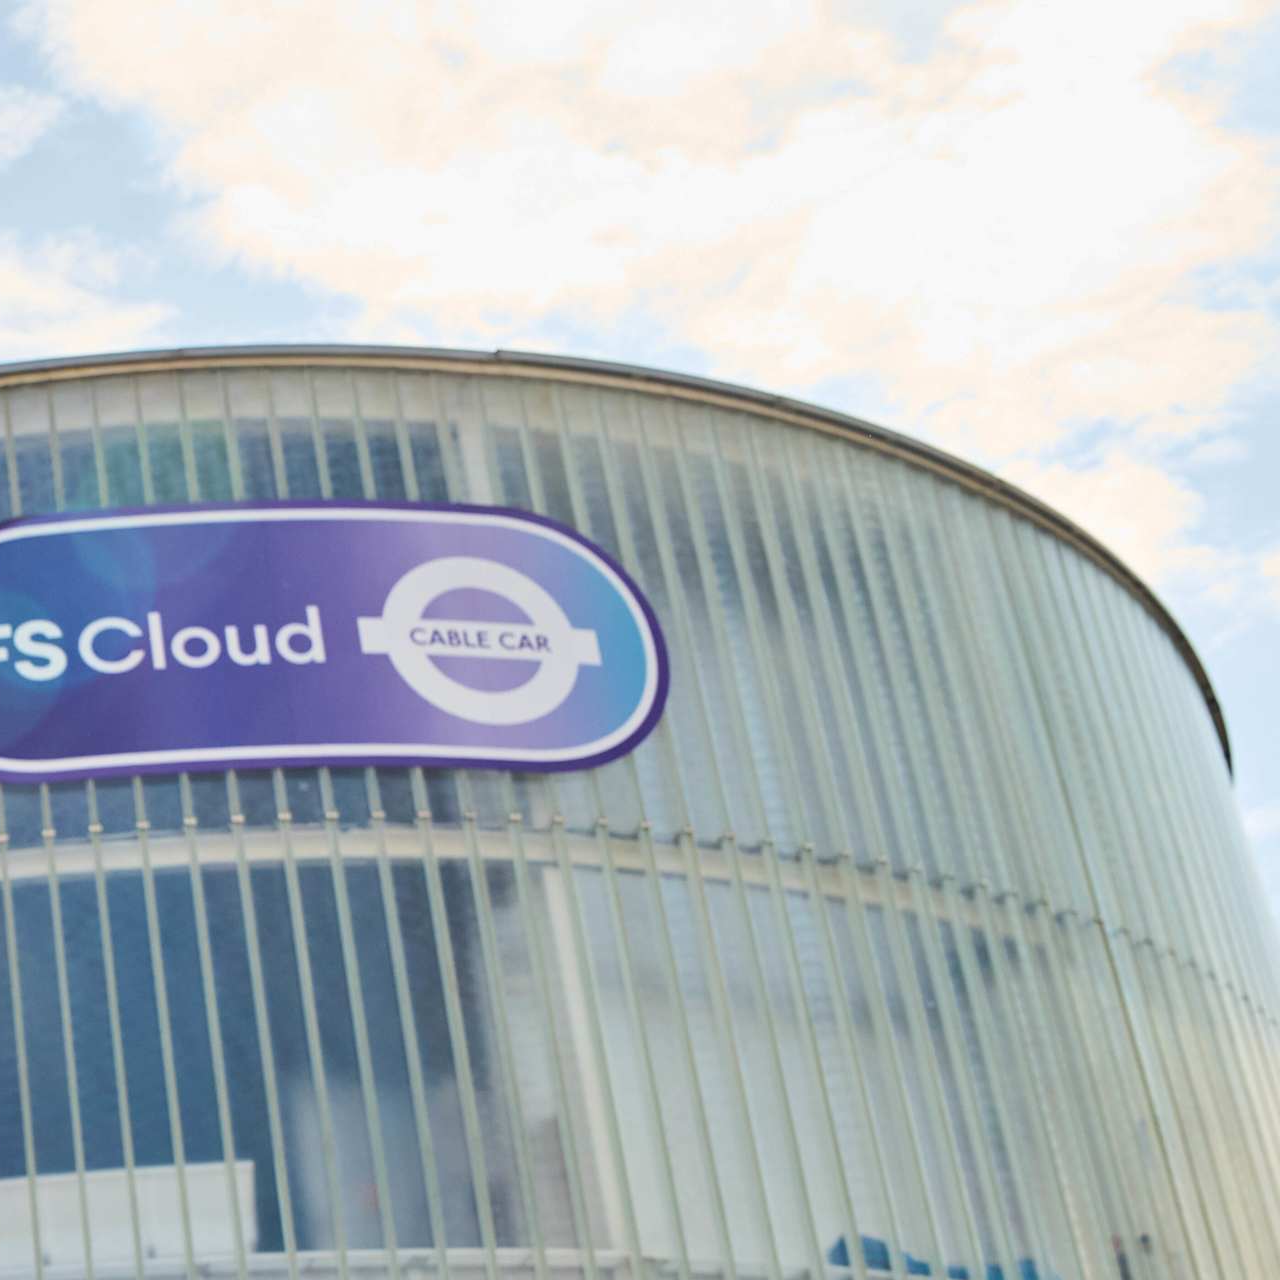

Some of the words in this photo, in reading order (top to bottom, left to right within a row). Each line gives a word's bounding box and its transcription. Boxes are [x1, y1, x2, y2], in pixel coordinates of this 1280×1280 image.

[77, 605, 327, 675] Cloud
[408, 626, 491, 652] CABLE
[496, 630, 553, 655] CAR
